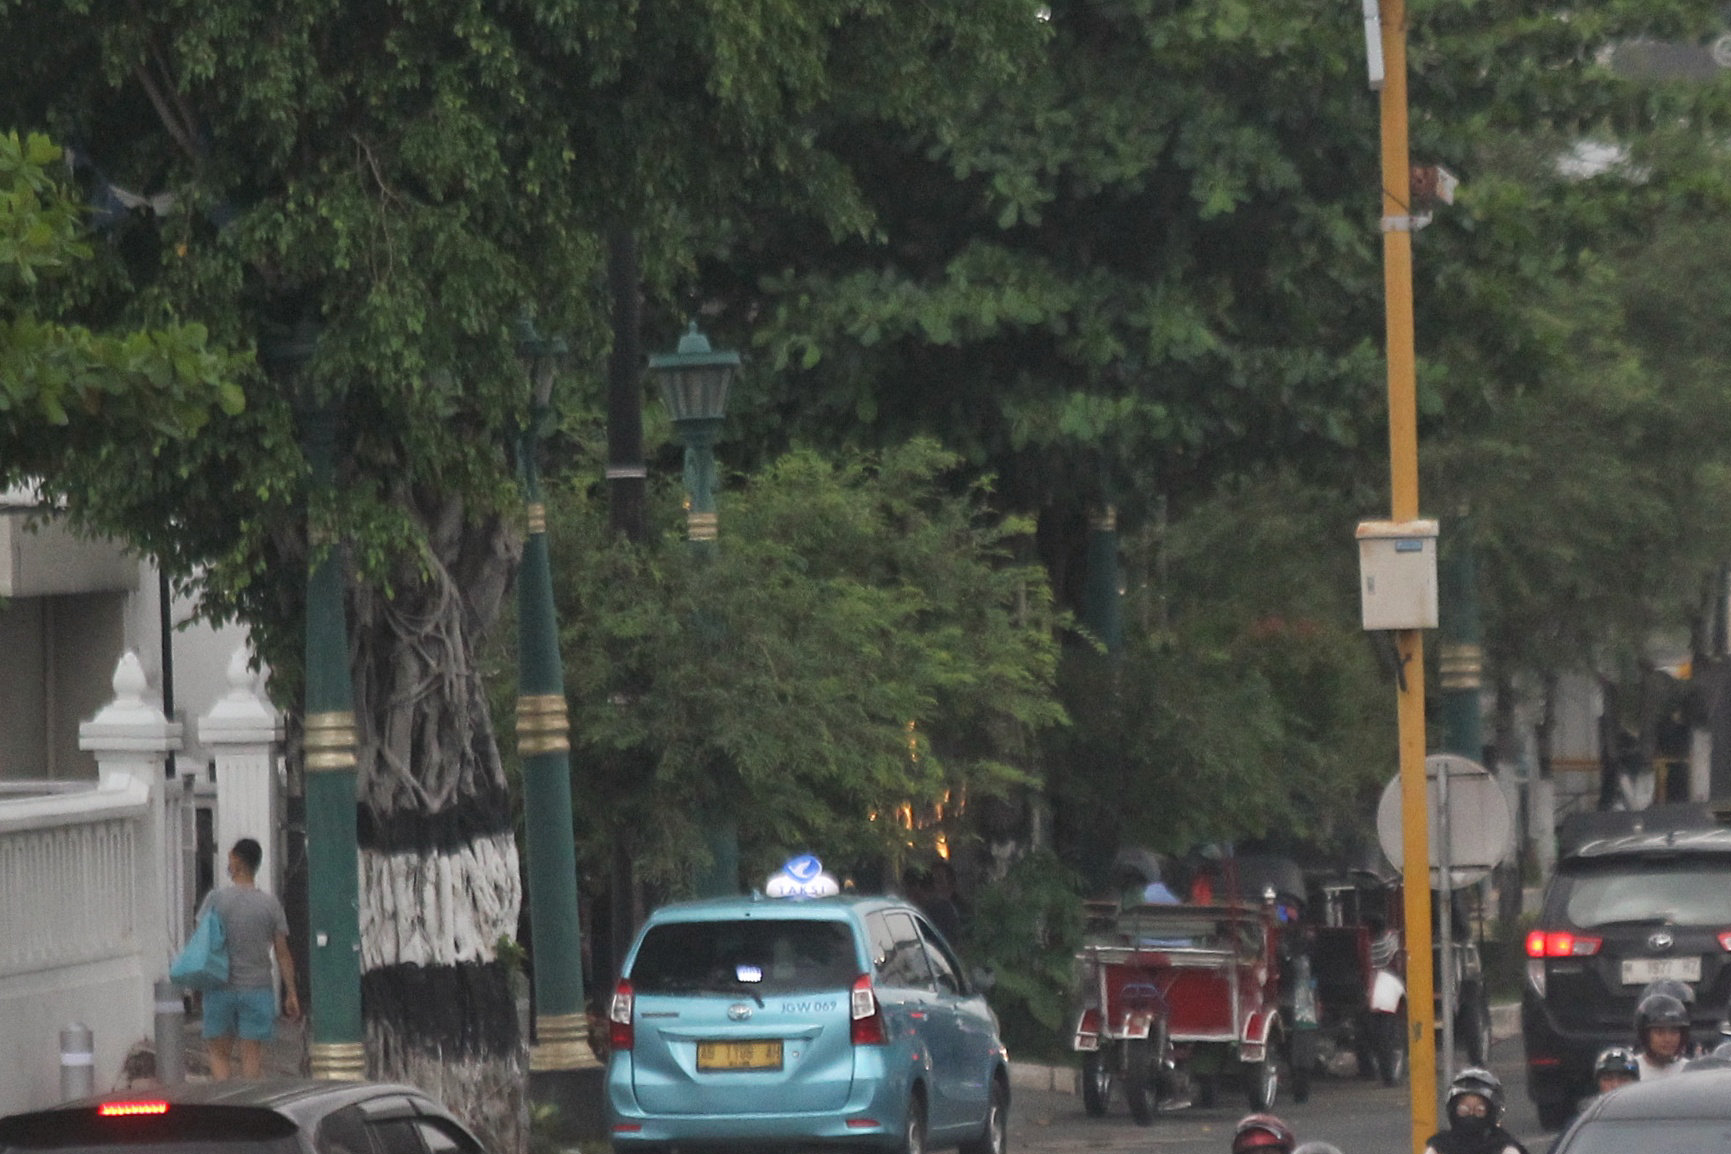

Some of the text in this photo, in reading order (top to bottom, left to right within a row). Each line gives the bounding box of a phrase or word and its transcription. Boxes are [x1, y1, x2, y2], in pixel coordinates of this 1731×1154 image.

[779, 885, 825, 896] TAKSI
[781, 1001, 838, 1013] JGW 069
